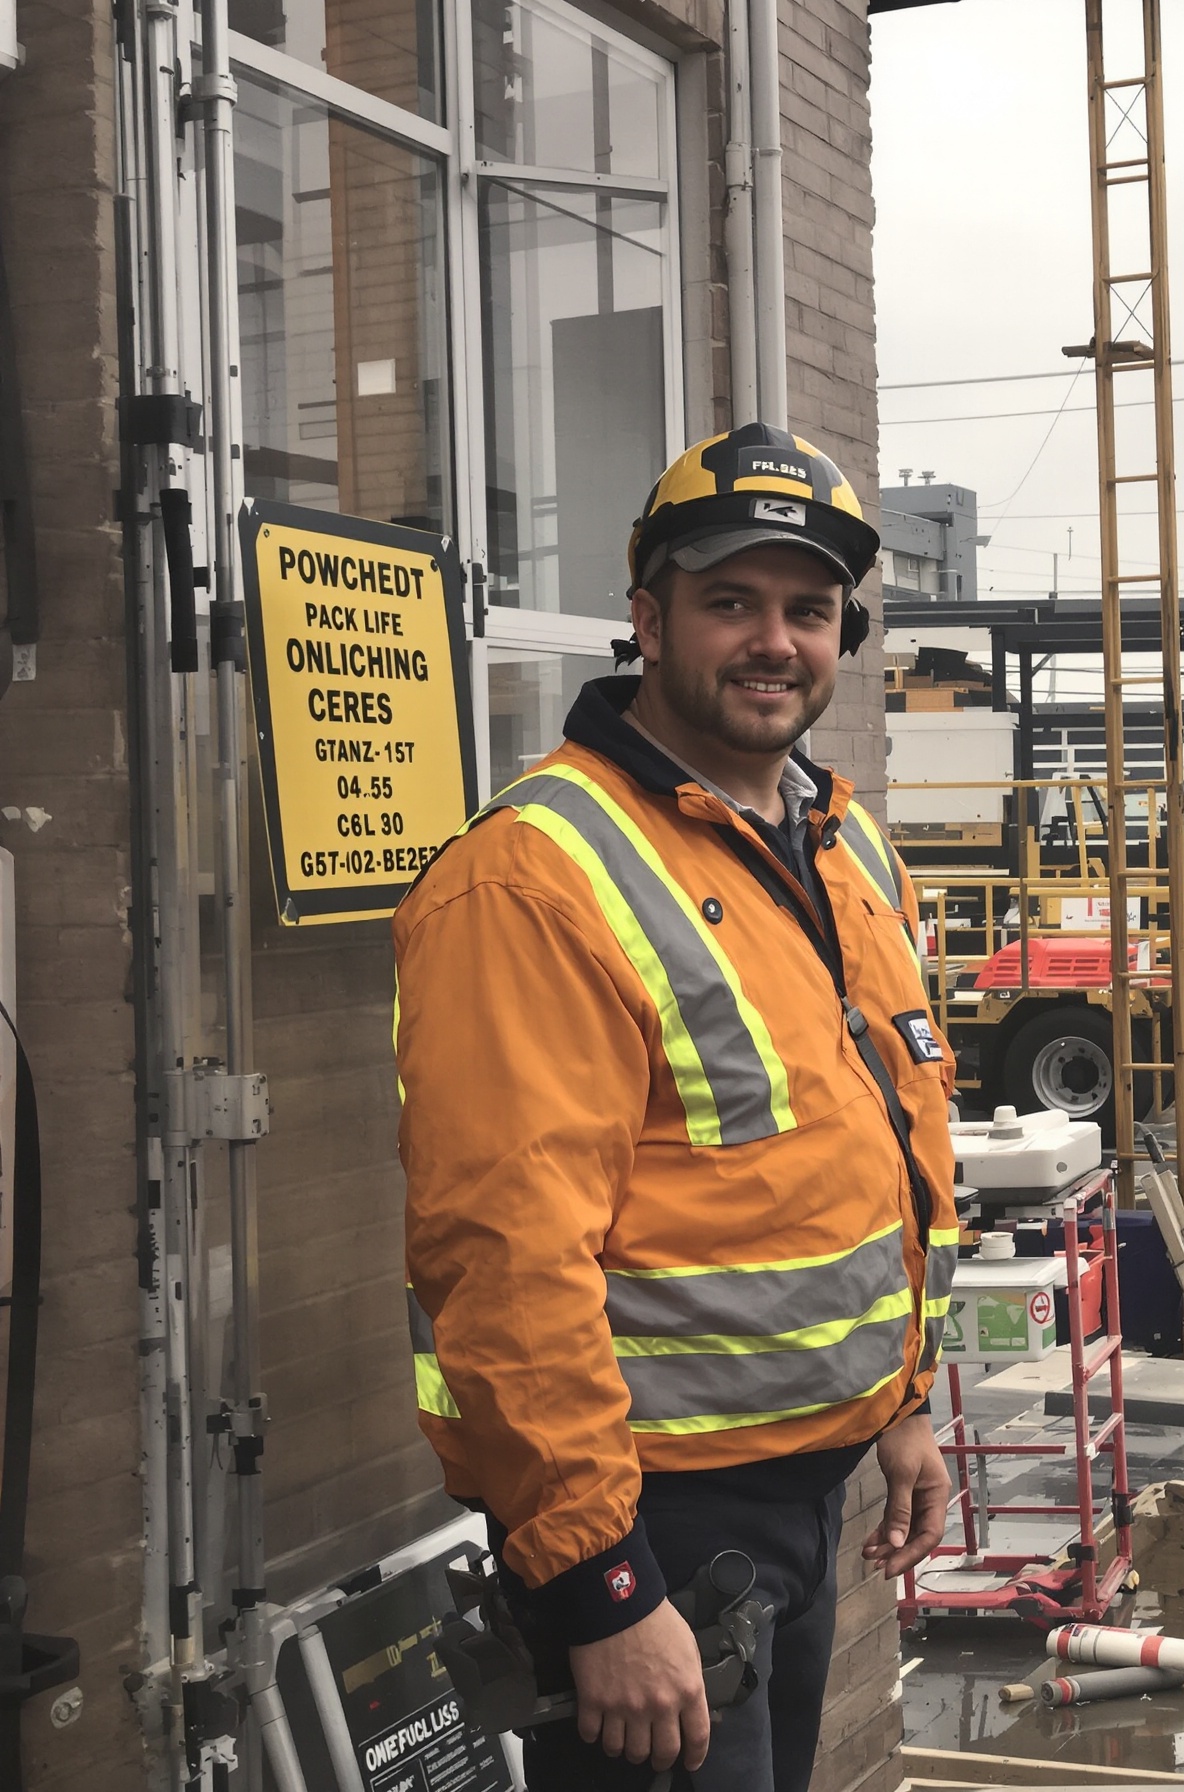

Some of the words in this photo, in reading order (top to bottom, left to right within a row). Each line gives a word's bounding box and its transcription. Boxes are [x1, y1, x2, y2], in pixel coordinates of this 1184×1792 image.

[279, 546, 424, 600] POWCHEDT
[305, 602, 358, 632] PACK
[364, 609, 404, 637] LIFE
[286, 638, 429, 682] ONLICHING
[308, 688, 393, 725] CERES
[380, 812, 404, 836] 30
